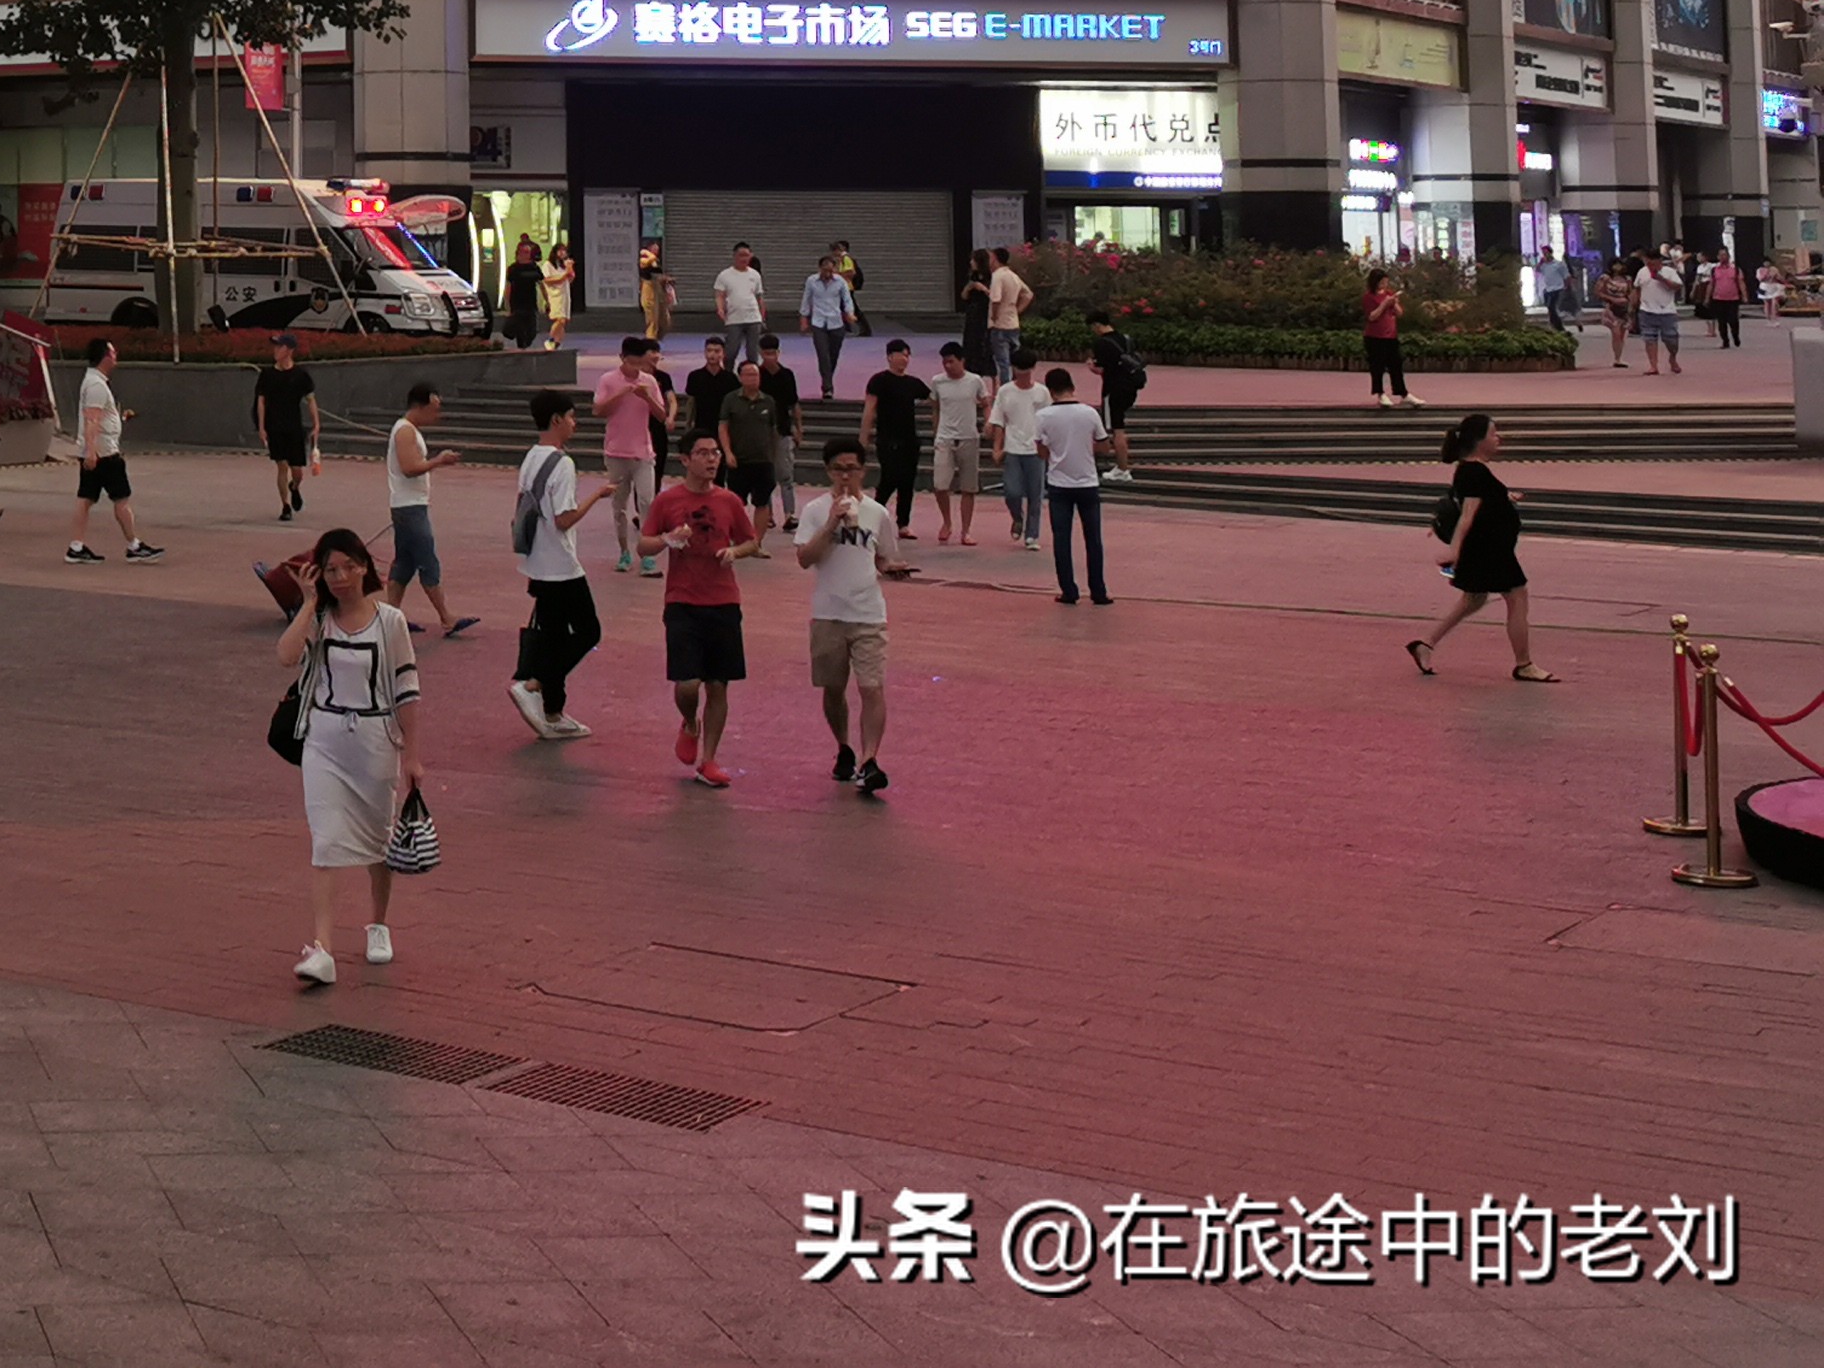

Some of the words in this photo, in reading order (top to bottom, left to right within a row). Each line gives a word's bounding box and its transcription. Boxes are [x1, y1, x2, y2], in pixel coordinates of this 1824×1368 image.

[634, 3, 891, 45] 赛格电子市场
[906, 10, 978, 39] SEG
[984, 13, 1166, 39] E-MARKET
[1055, 148, 1102, 157] FOREIGN
[1108, 148, 1166, 157] CURRENCY
[225, 286, 258, 303] 公安
